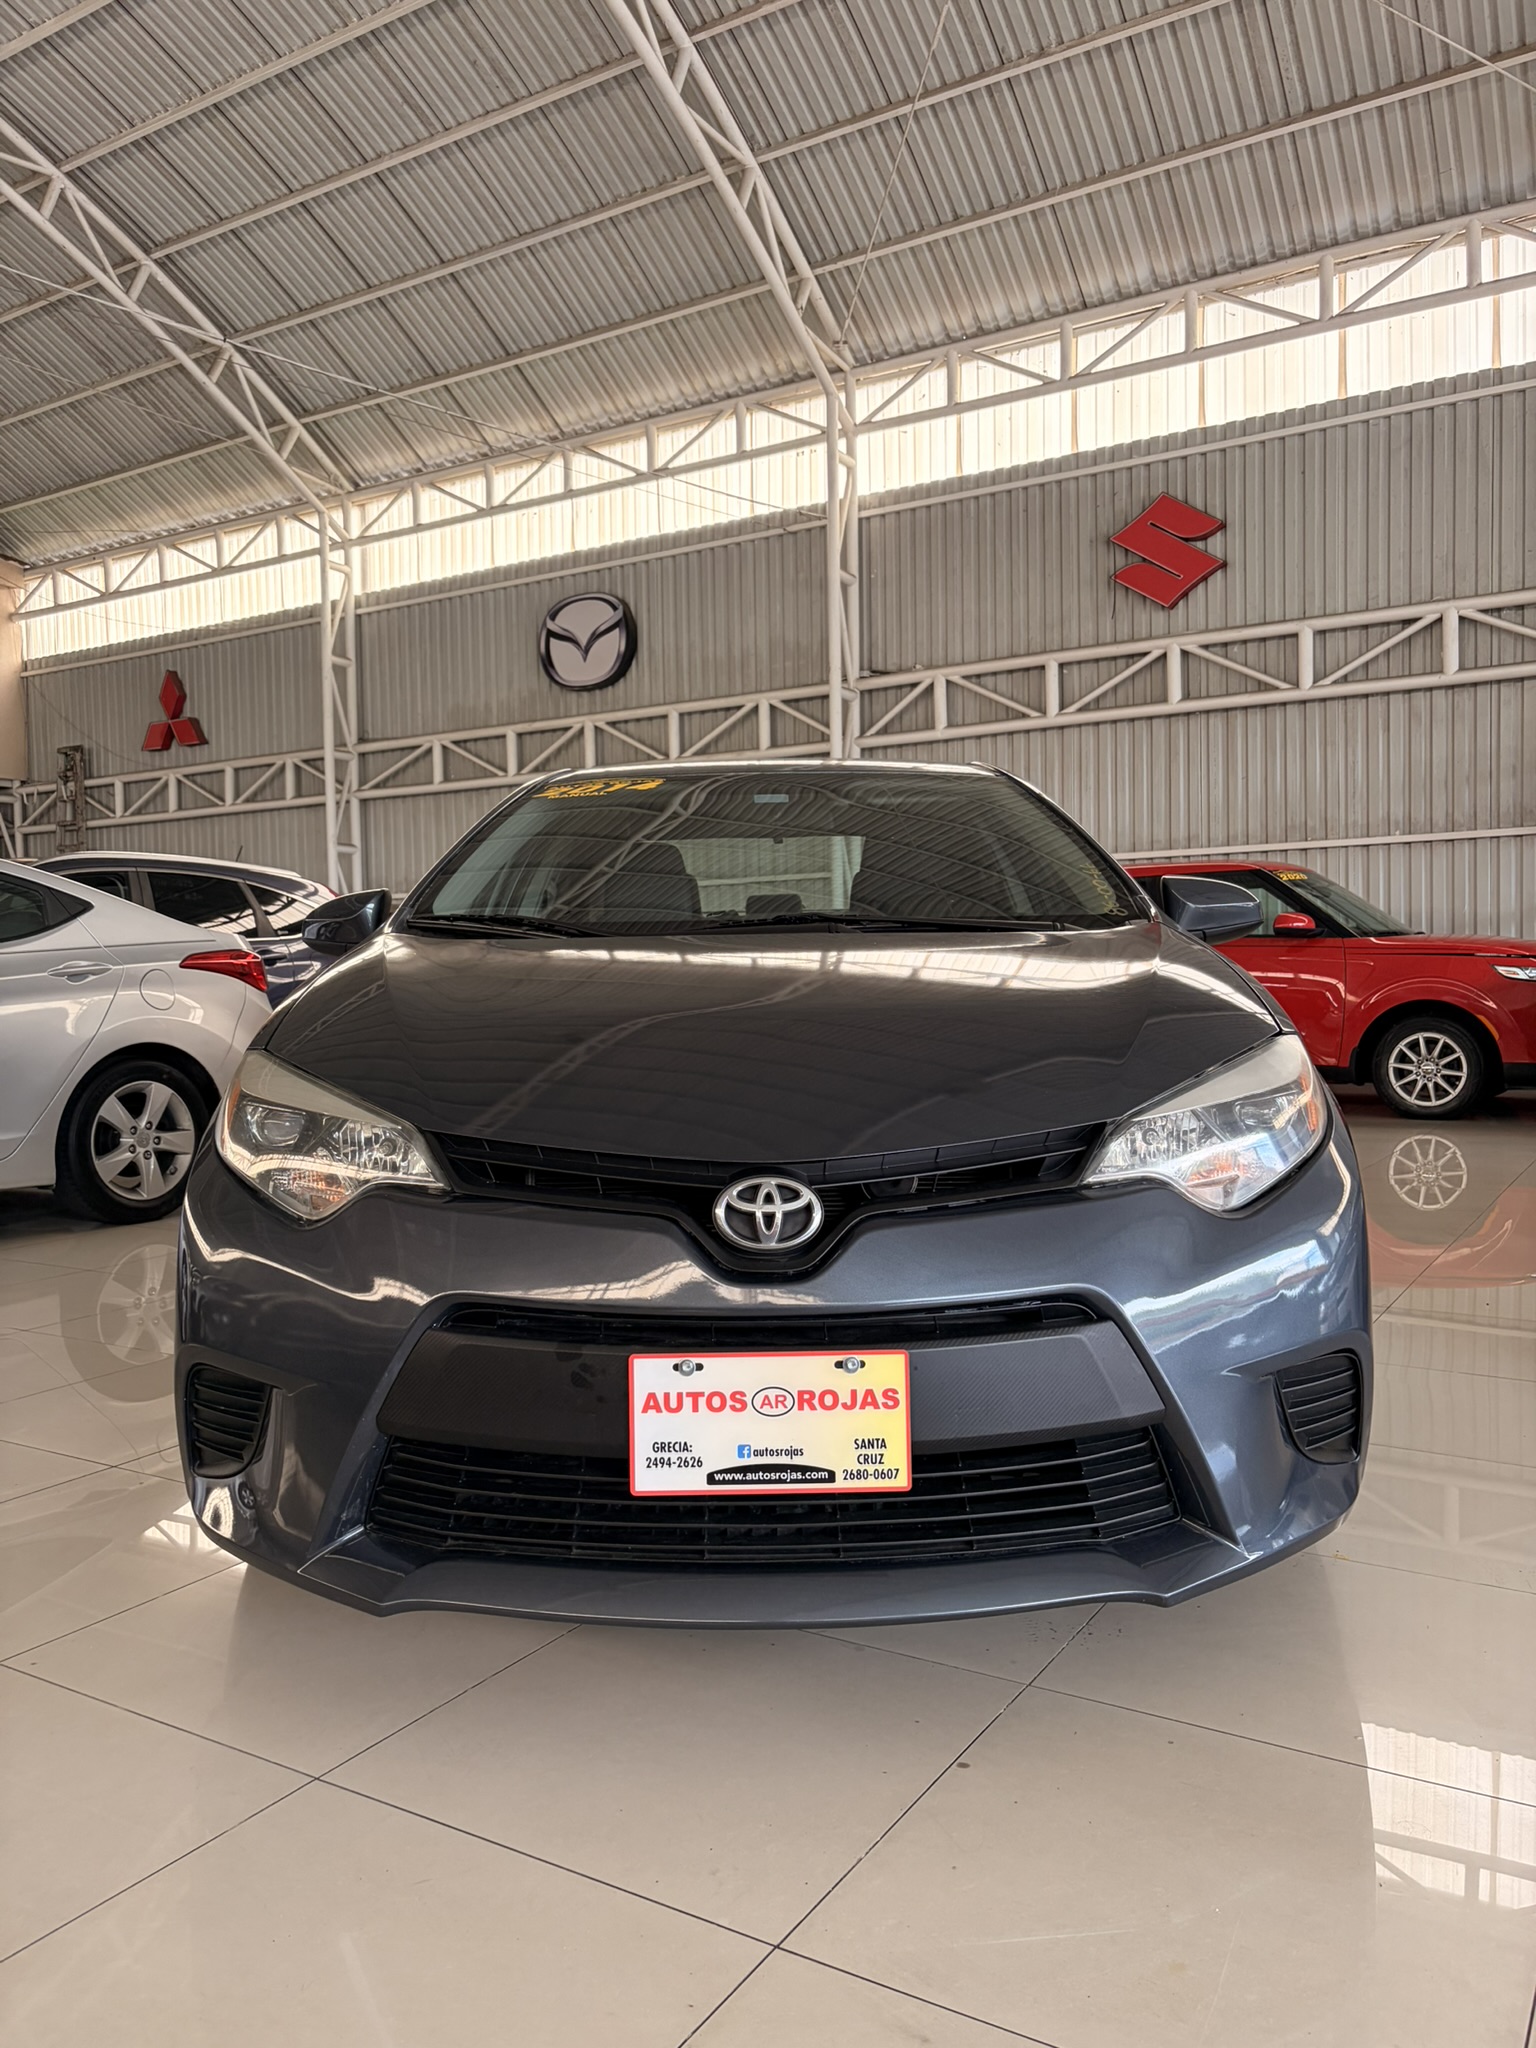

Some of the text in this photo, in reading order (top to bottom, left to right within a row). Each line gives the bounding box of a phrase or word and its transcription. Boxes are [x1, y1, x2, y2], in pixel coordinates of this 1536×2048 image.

[547, 791, 607, 800] MANUAL
[641, 1388, 901, 1414] AUTOS AR ROJAS
[652, 1441, 693, 1454] GRECIA:
[854, 1437, 887, 1450] SANTA
[752, 1444, 804, 1460] autosrojas
[645, 1456, 703, 1469] 2494-2626
[856, 1452, 885, 1466] CRUZ
[714, 1470, 829, 1483] www.autosrojas.com
[842, 1467, 900, 1482] 2680-0607
